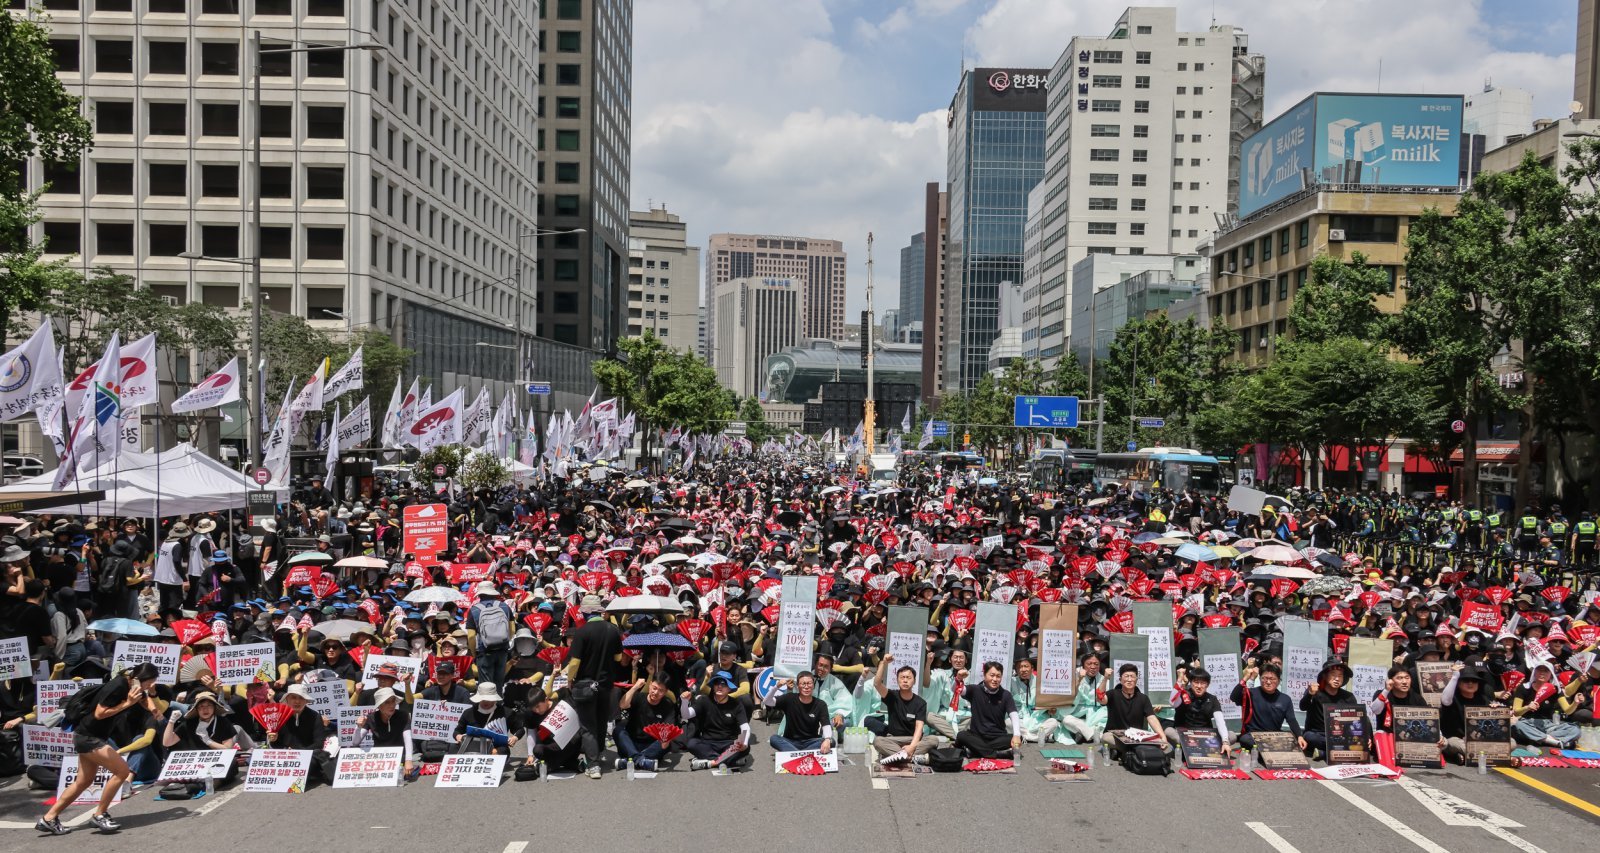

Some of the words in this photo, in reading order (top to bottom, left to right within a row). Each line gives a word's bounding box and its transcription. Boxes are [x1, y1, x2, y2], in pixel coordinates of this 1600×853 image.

[1078, 50, 1091, 111] 삼정빌딩
[1391, 124, 1450, 141] 복사지는
[1276, 127, 1305, 155] 복사지는
[1391, 143, 1441, 162] miilk
[1275, 150, 1300, 184] miilk
[786, 634, 806, 646] 10%
[149, 645, 168, 654] NO!
[219, 650, 245, 659] 공무원도
[247, 647, 272, 656] 국민이다
[117, 653, 153, 663] 소득공백
[154, 656, 176, 665] 해소!
[219, 657, 260, 668] 정치기본권
[219, 667, 255, 678] 보장하라!
[1044, 668, 1070, 681] 7.1%
[416, 702, 430, 710] 임금
[431, 703, 449, 712] 7.1%
[340, 710, 361, 718] 공무원
[414, 720, 450, 731] 직급보조비
[251, 760, 276, 768] 공무원도
[276, 760, 301, 768] 노동자다
[340, 761, 362, 772] 통장
[364, 760, 397, 772] 잔고가
[447, 757, 475, 766] 중요한
[476, 757, 495, 765] 것은
[165, 769, 198, 777] 인상하라!
[249, 768, 276, 776] 안전하게
[277, 769, 292, 777] 일할
[292, 769, 306, 777] 권리
[473, 765, 492, 774] 않는
[247, 776, 277, 785] 보장하라!
[441, 774, 461, 782] 연금
